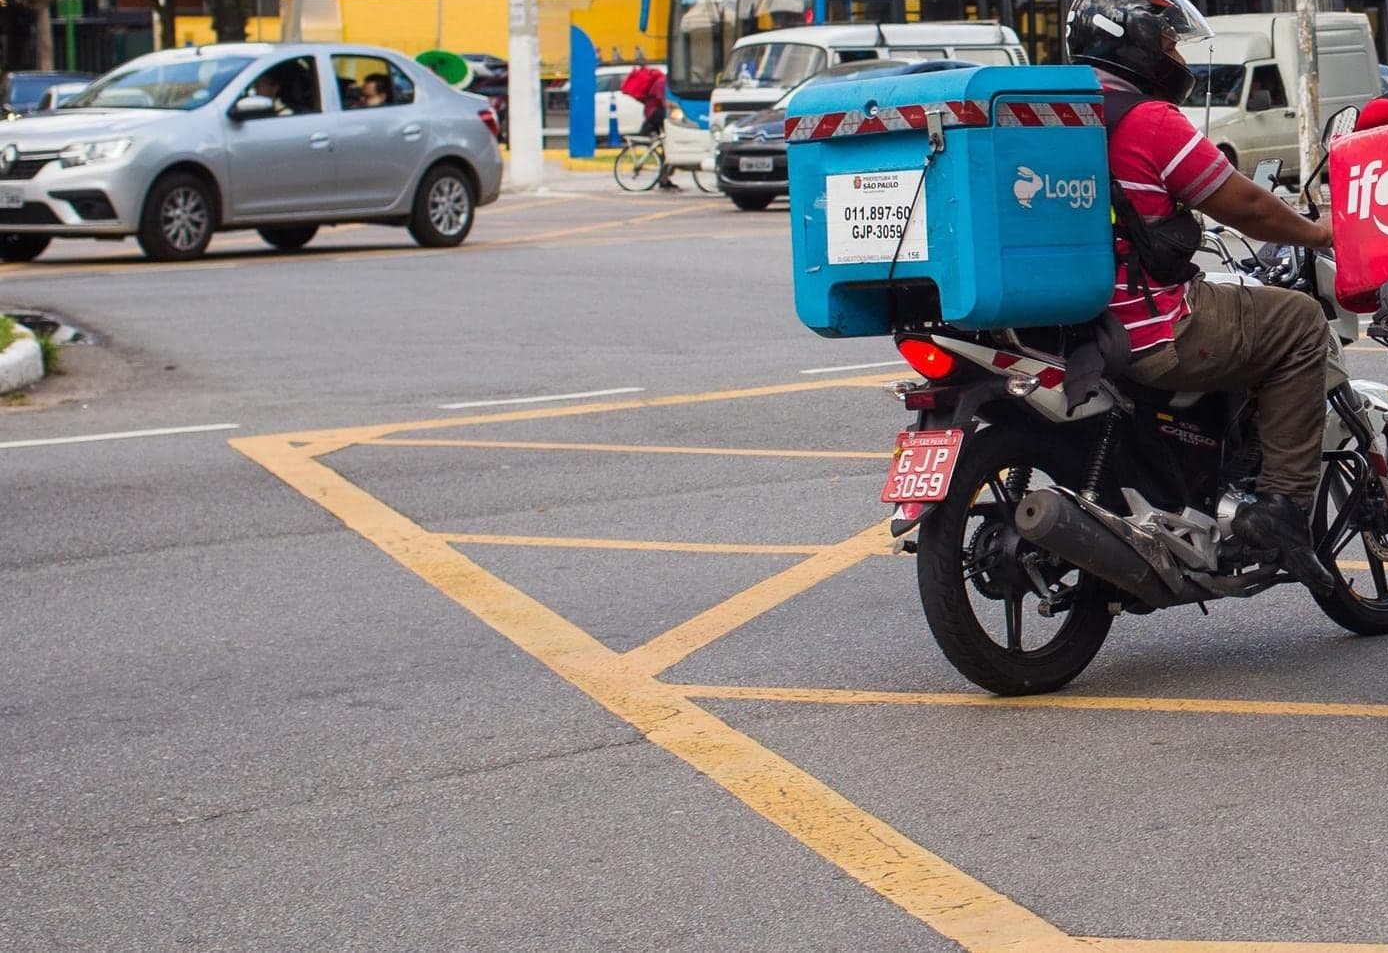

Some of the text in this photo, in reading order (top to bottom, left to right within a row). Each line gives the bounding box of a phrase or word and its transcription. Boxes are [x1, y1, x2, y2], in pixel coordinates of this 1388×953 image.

[877, 181, 899, 189] PAULO
[1045, 174, 1097, 209] Loggi
[844, 205, 912, 221] 011.897-60
[852, 224, 903, 239] GJP-3059
[897, 448, 949, 473] GJP
[888, 472, 944, 498] 3059
